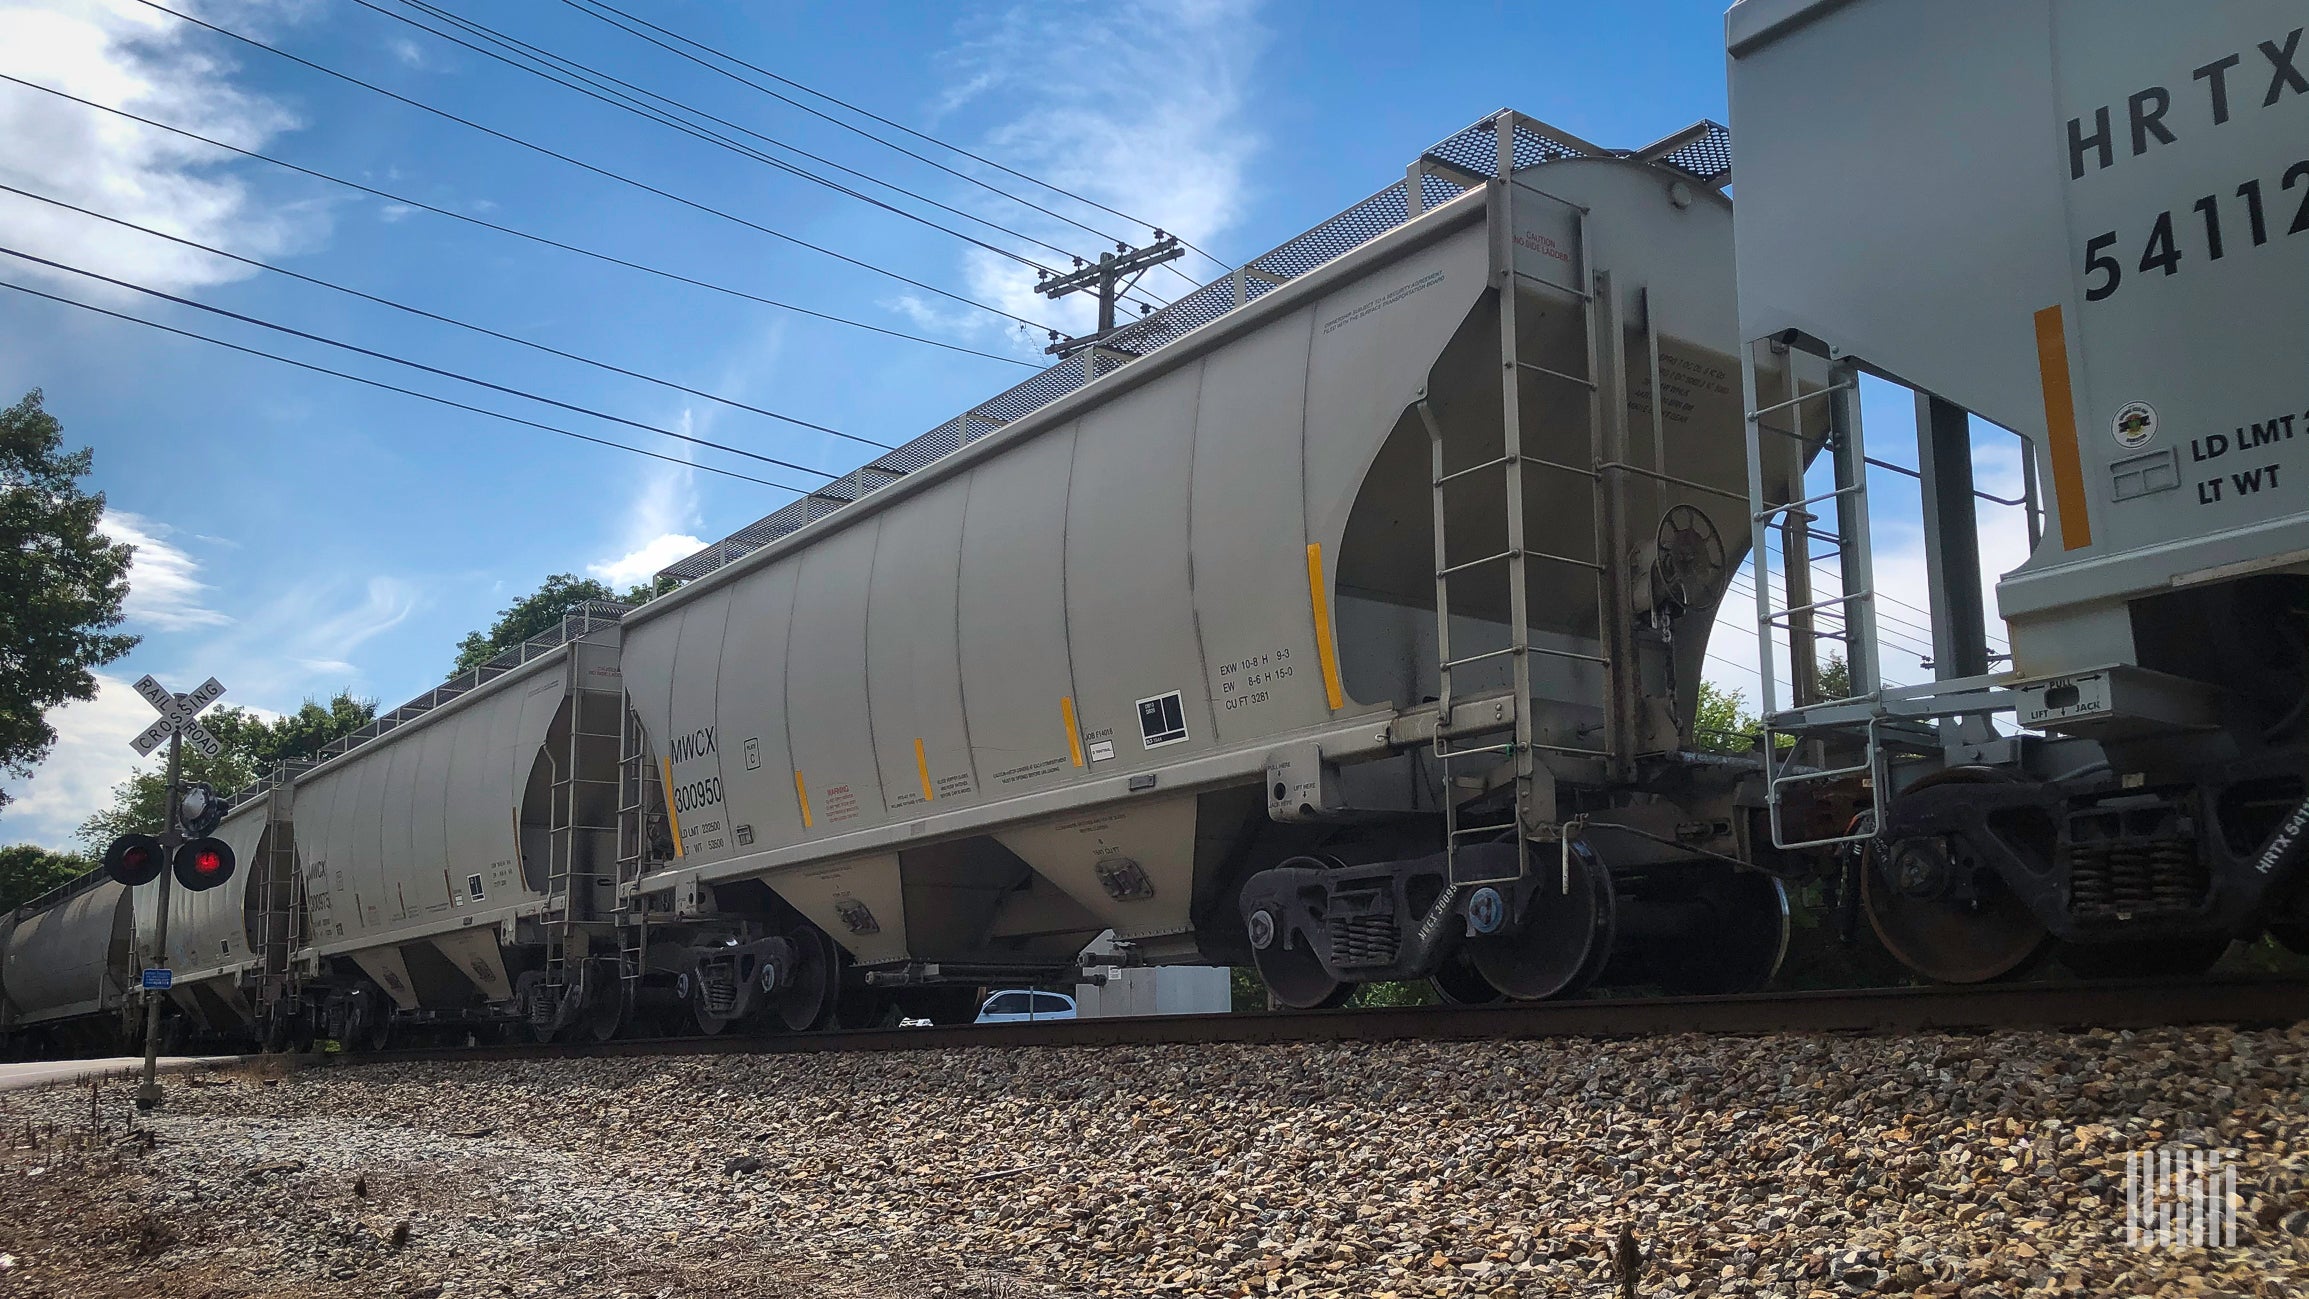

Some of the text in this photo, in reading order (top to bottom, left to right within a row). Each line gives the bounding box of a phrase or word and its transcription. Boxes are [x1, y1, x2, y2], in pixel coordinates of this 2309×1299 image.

[2067, 27, 2309, 181] HRTX
[1525, 240, 1540, 252] SIDE
[1541, 246, 1569, 262] LADDER
[1527, 231, 1555, 248] CAUTION
[2191, 434, 2229, 462] LD
[2236, 413, 2296, 451] LMT
[2198, 463, 2280, 505] LT WT
[1220, 648, 1290, 676] EXW 10-8 H 9-3
[1223, 666, 1293, 693] EW 8-6 H 15-0
[2049, 678, 2072, 689] PULL
[1225, 691, 1269, 710] CU FT 3281
[2031, 701, 2100, 720] LIFT JACK
[137, 678, 218, 755] RAIL ROAD
[138, 684, 218, 749] CROSSING
[671, 726, 716, 765] MWCX
[1085, 731, 1096, 741] JOB
[750, 753, 756, 764] C
[675, 777, 722, 813] 300950
[688, 825, 699, 838] LMT
[693, 843, 703, 854] WT
[2255, 833, 2293, 874] HRTX
